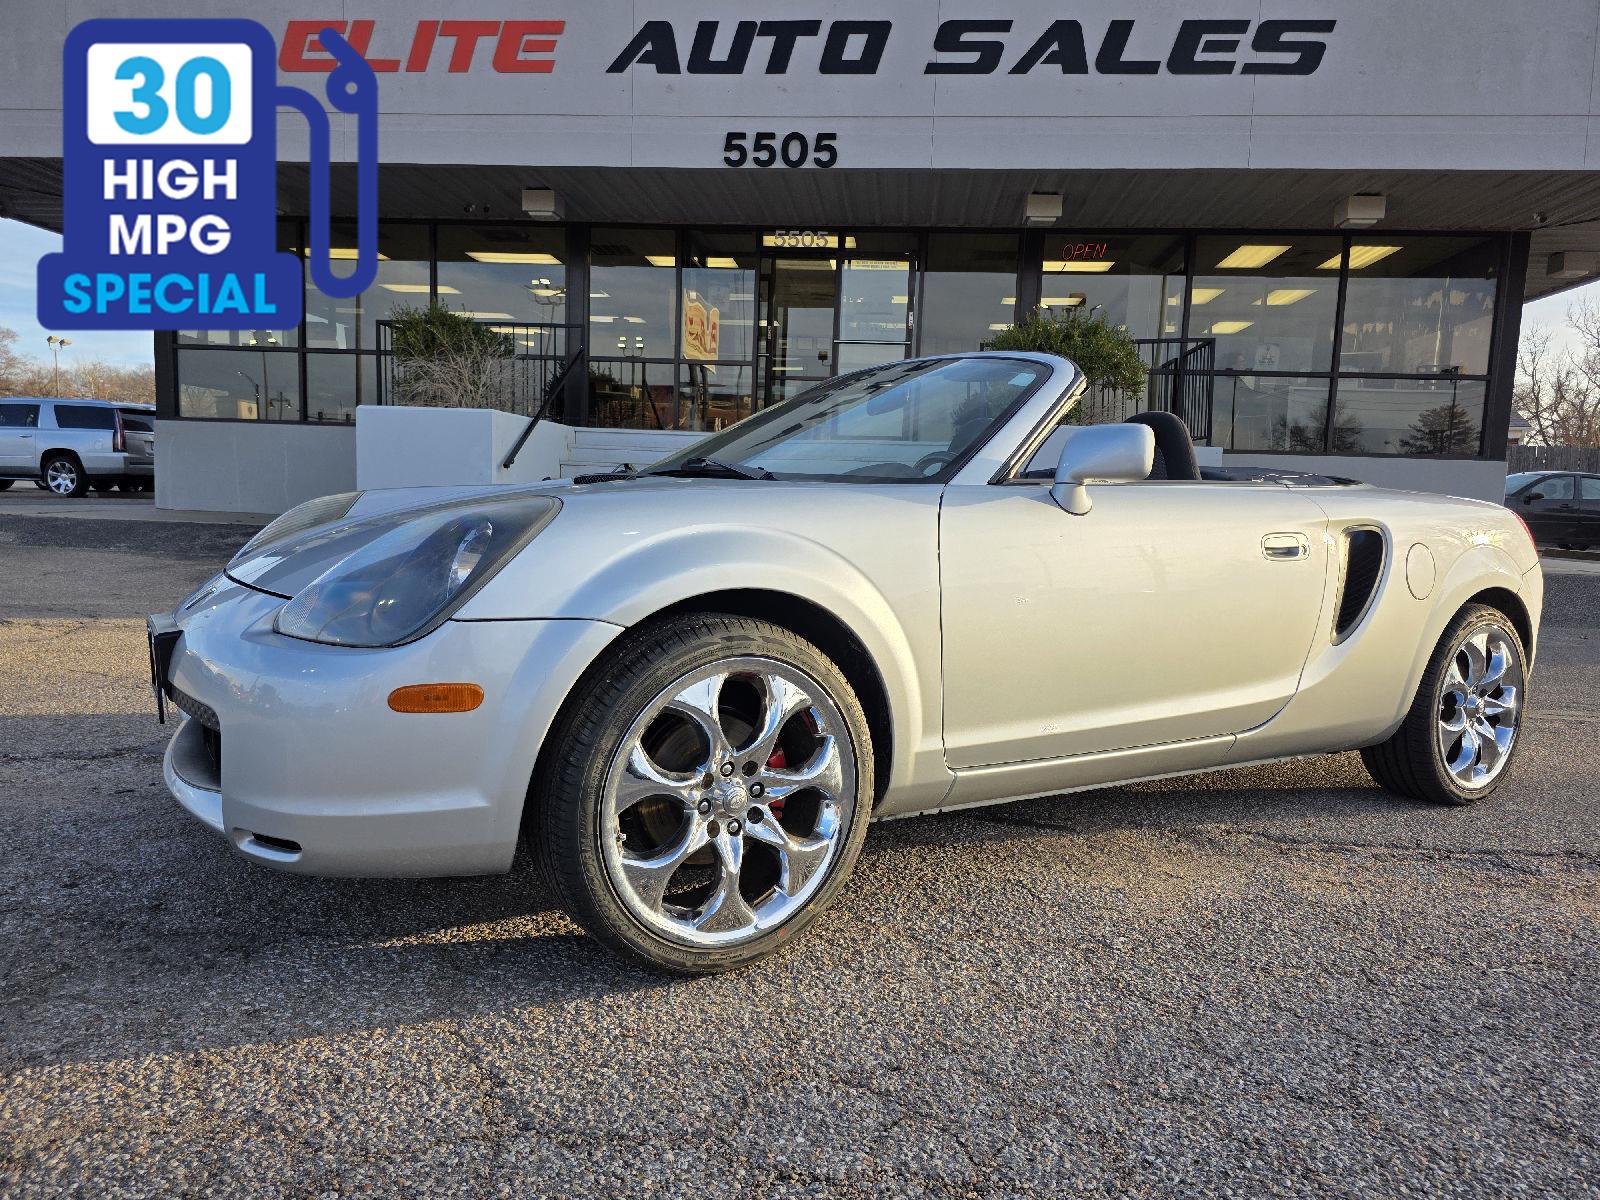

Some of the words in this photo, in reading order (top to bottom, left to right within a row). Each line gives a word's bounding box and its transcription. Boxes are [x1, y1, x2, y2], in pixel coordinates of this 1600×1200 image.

[278, 20, 566, 73] ELITE
[606, 20, 893, 74] AUTO
[924, 19, 1337, 76] SALES
[723, 131, 838, 168] 5505
[774, 230, 829, 247] 5505
[1062, 242, 1108, 261] OPEN
